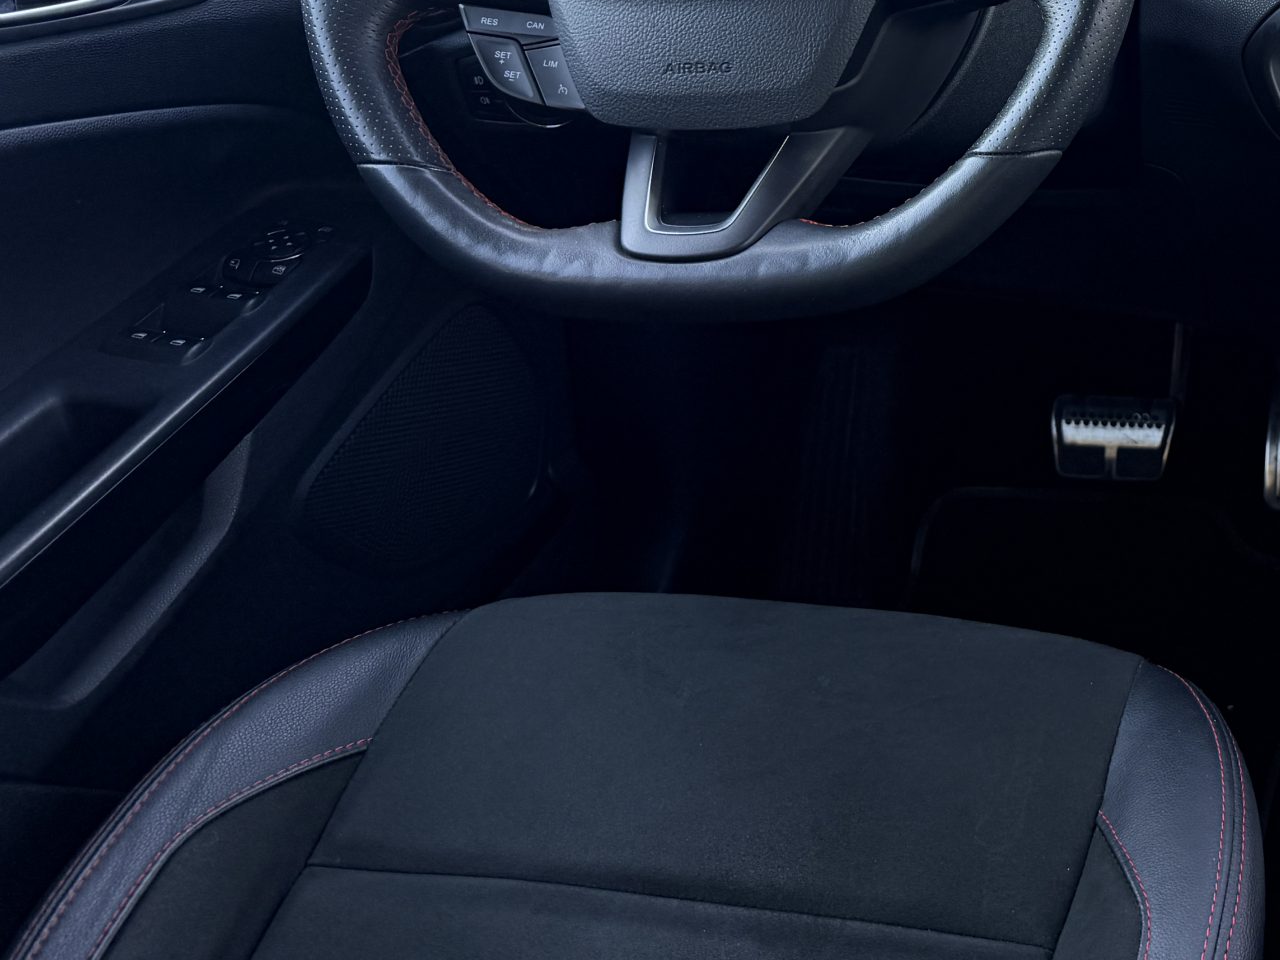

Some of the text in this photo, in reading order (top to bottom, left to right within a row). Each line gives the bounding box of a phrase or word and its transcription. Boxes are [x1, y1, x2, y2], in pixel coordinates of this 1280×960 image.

[480, 16, 499, 26] RES
[526, 20, 545, 30] CAN
[494, 50, 512, 59] SET
[543, 59, 558, 68] LIM
[661, 60, 733, 76] AIRBAG
[503, 70, 521, 79] SET
